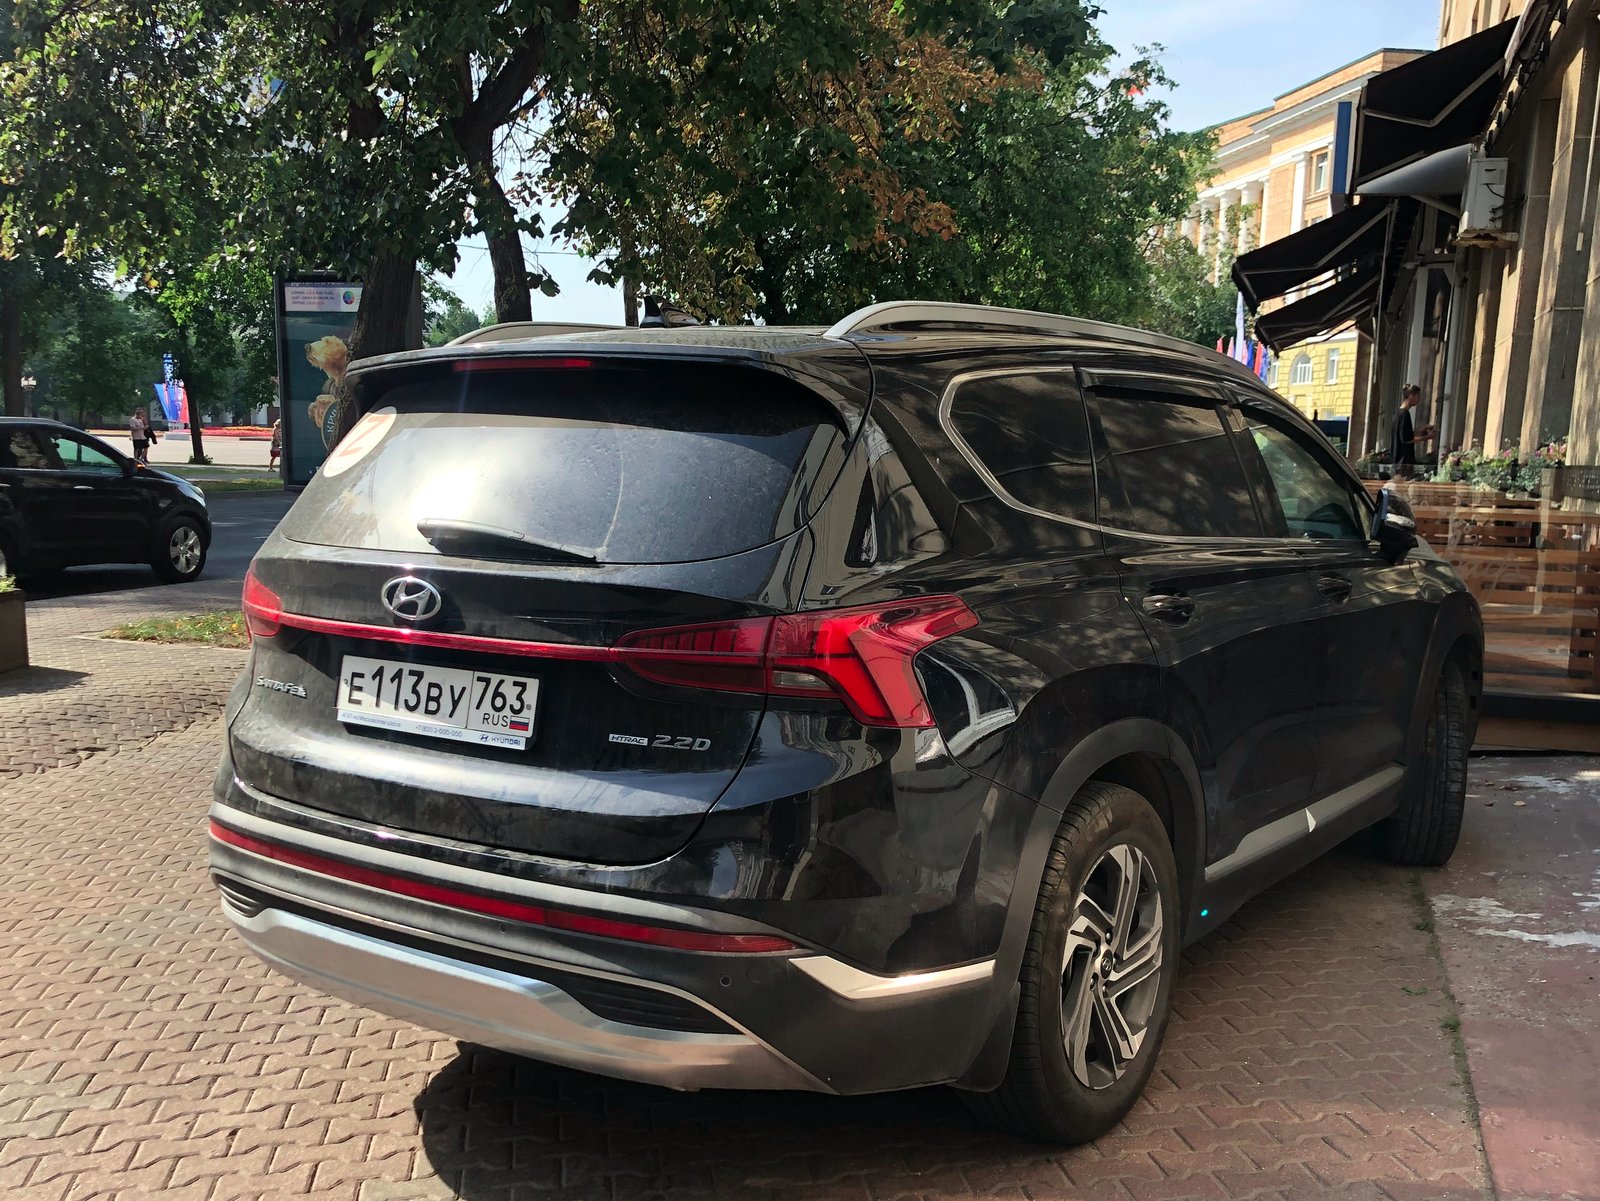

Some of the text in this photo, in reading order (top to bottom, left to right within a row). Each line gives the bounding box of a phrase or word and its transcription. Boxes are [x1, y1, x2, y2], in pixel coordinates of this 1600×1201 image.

[475, 676, 527, 715] 763
[482, 712, 509, 728] RUS
[491, 737, 521, 746] HYUNDAI
[611, 735, 647, 745] HTRAC
